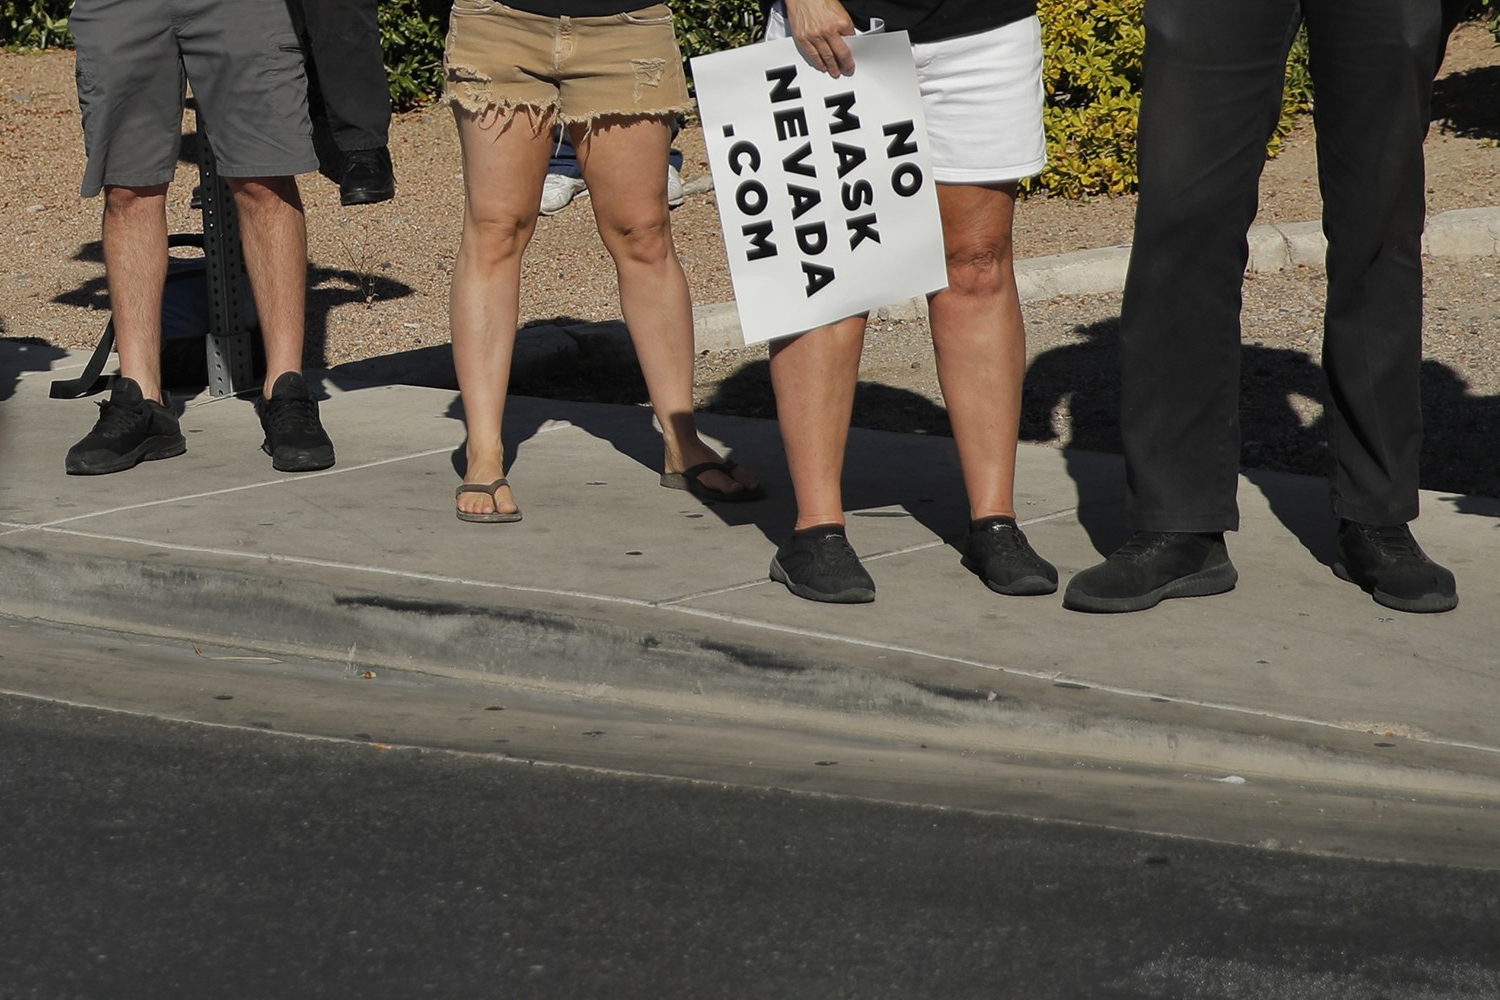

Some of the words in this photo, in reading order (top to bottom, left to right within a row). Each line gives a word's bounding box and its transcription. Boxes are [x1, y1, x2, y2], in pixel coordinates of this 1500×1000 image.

[722, 123, 778, 262] .COM
[765, 64, 836, 298] NEVADA
[823, 90, 882, 253] MASK
[882, 118, 924, 198] NO
